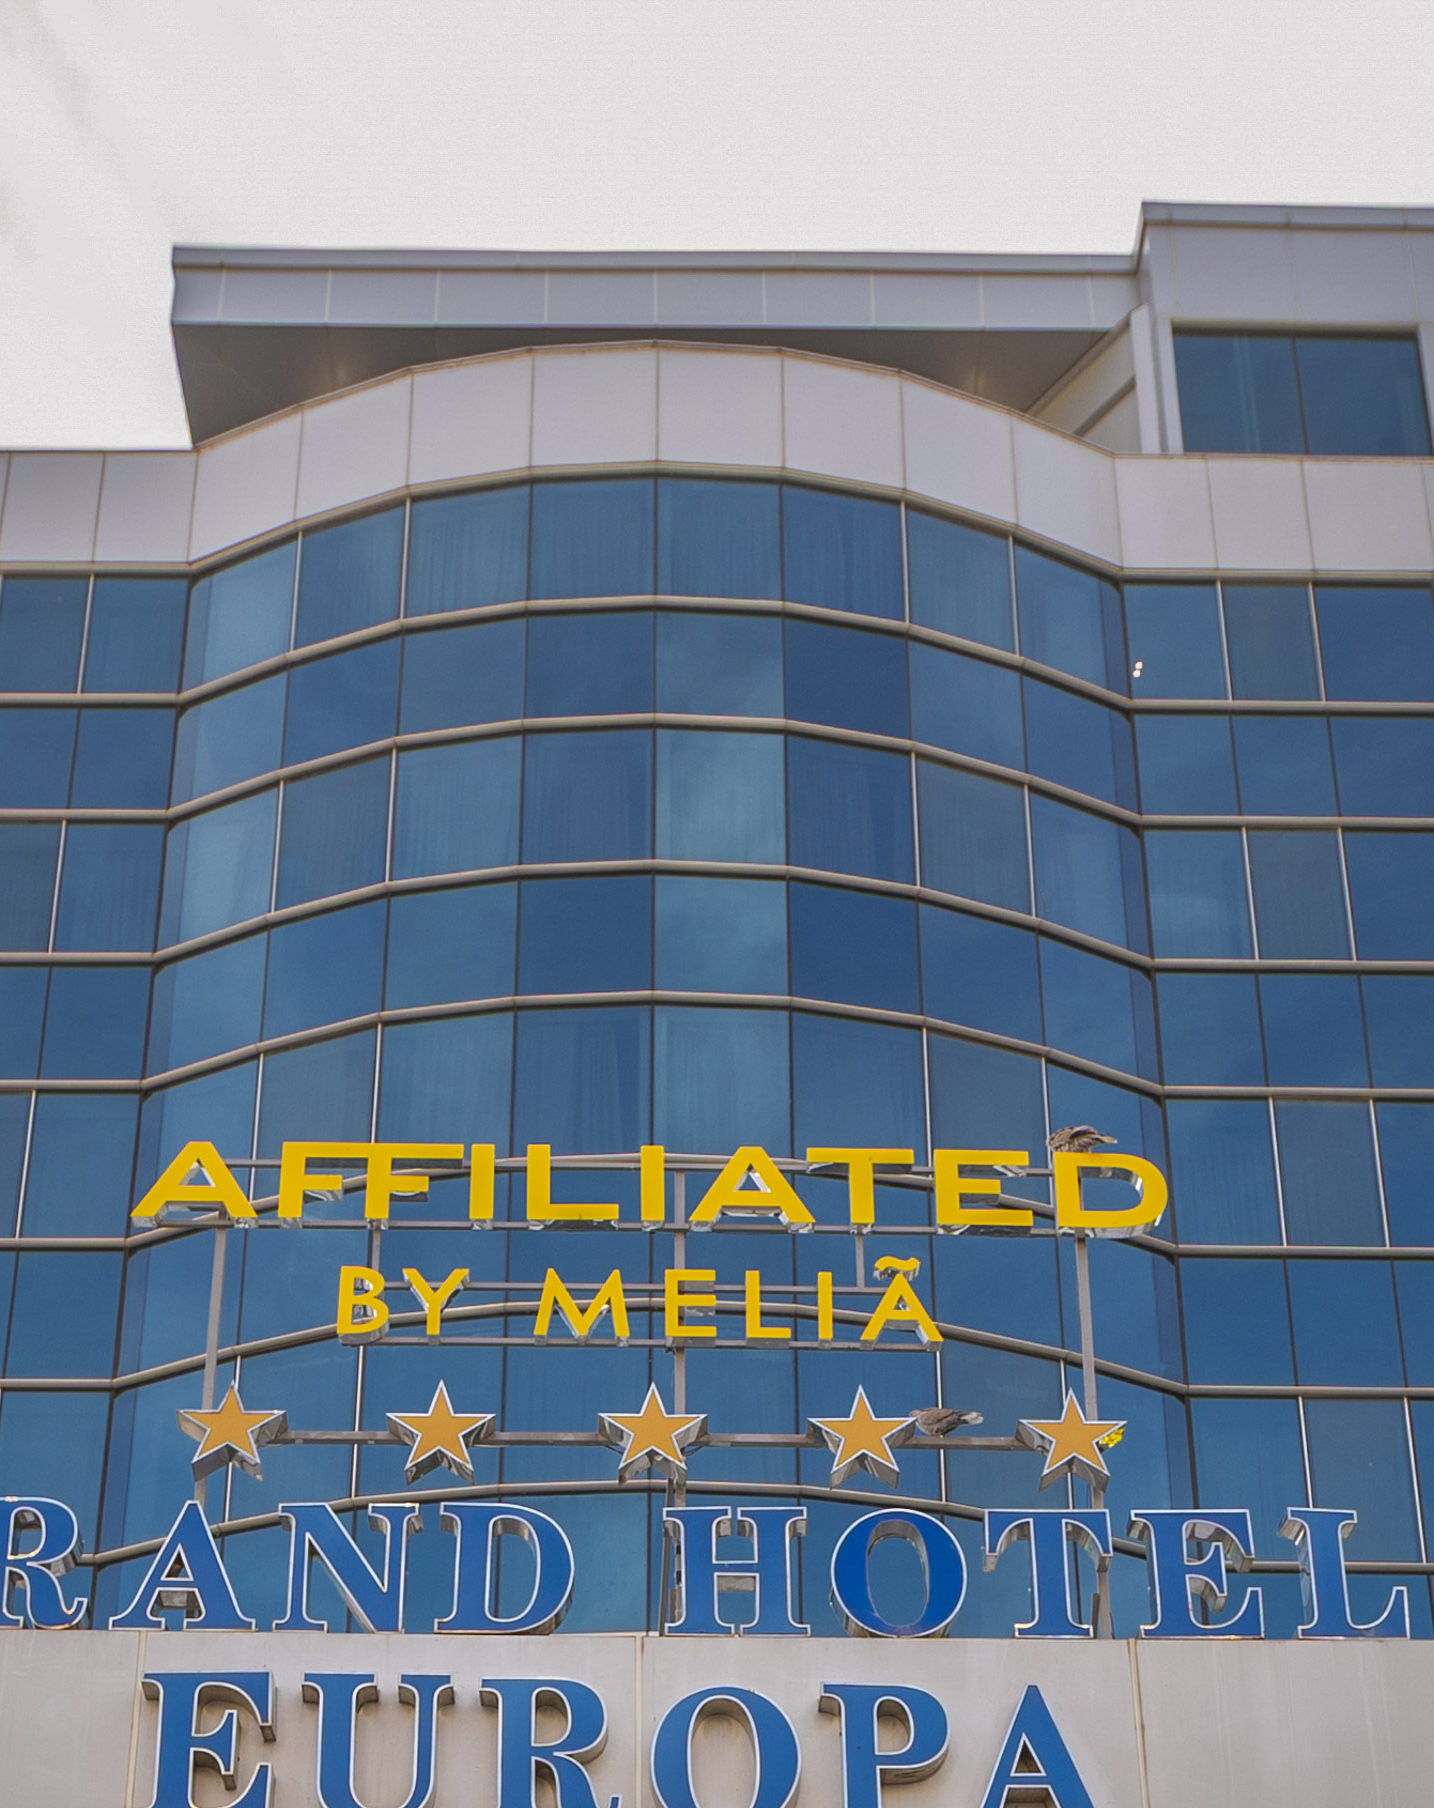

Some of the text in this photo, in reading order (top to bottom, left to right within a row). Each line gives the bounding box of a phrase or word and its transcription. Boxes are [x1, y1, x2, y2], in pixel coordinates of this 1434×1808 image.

[130, 1141, 1168, 1238] AFFILIATED
[337, 1266, 469, 1345] BY
[662, 1507, 1410, 1639] HOTEL
